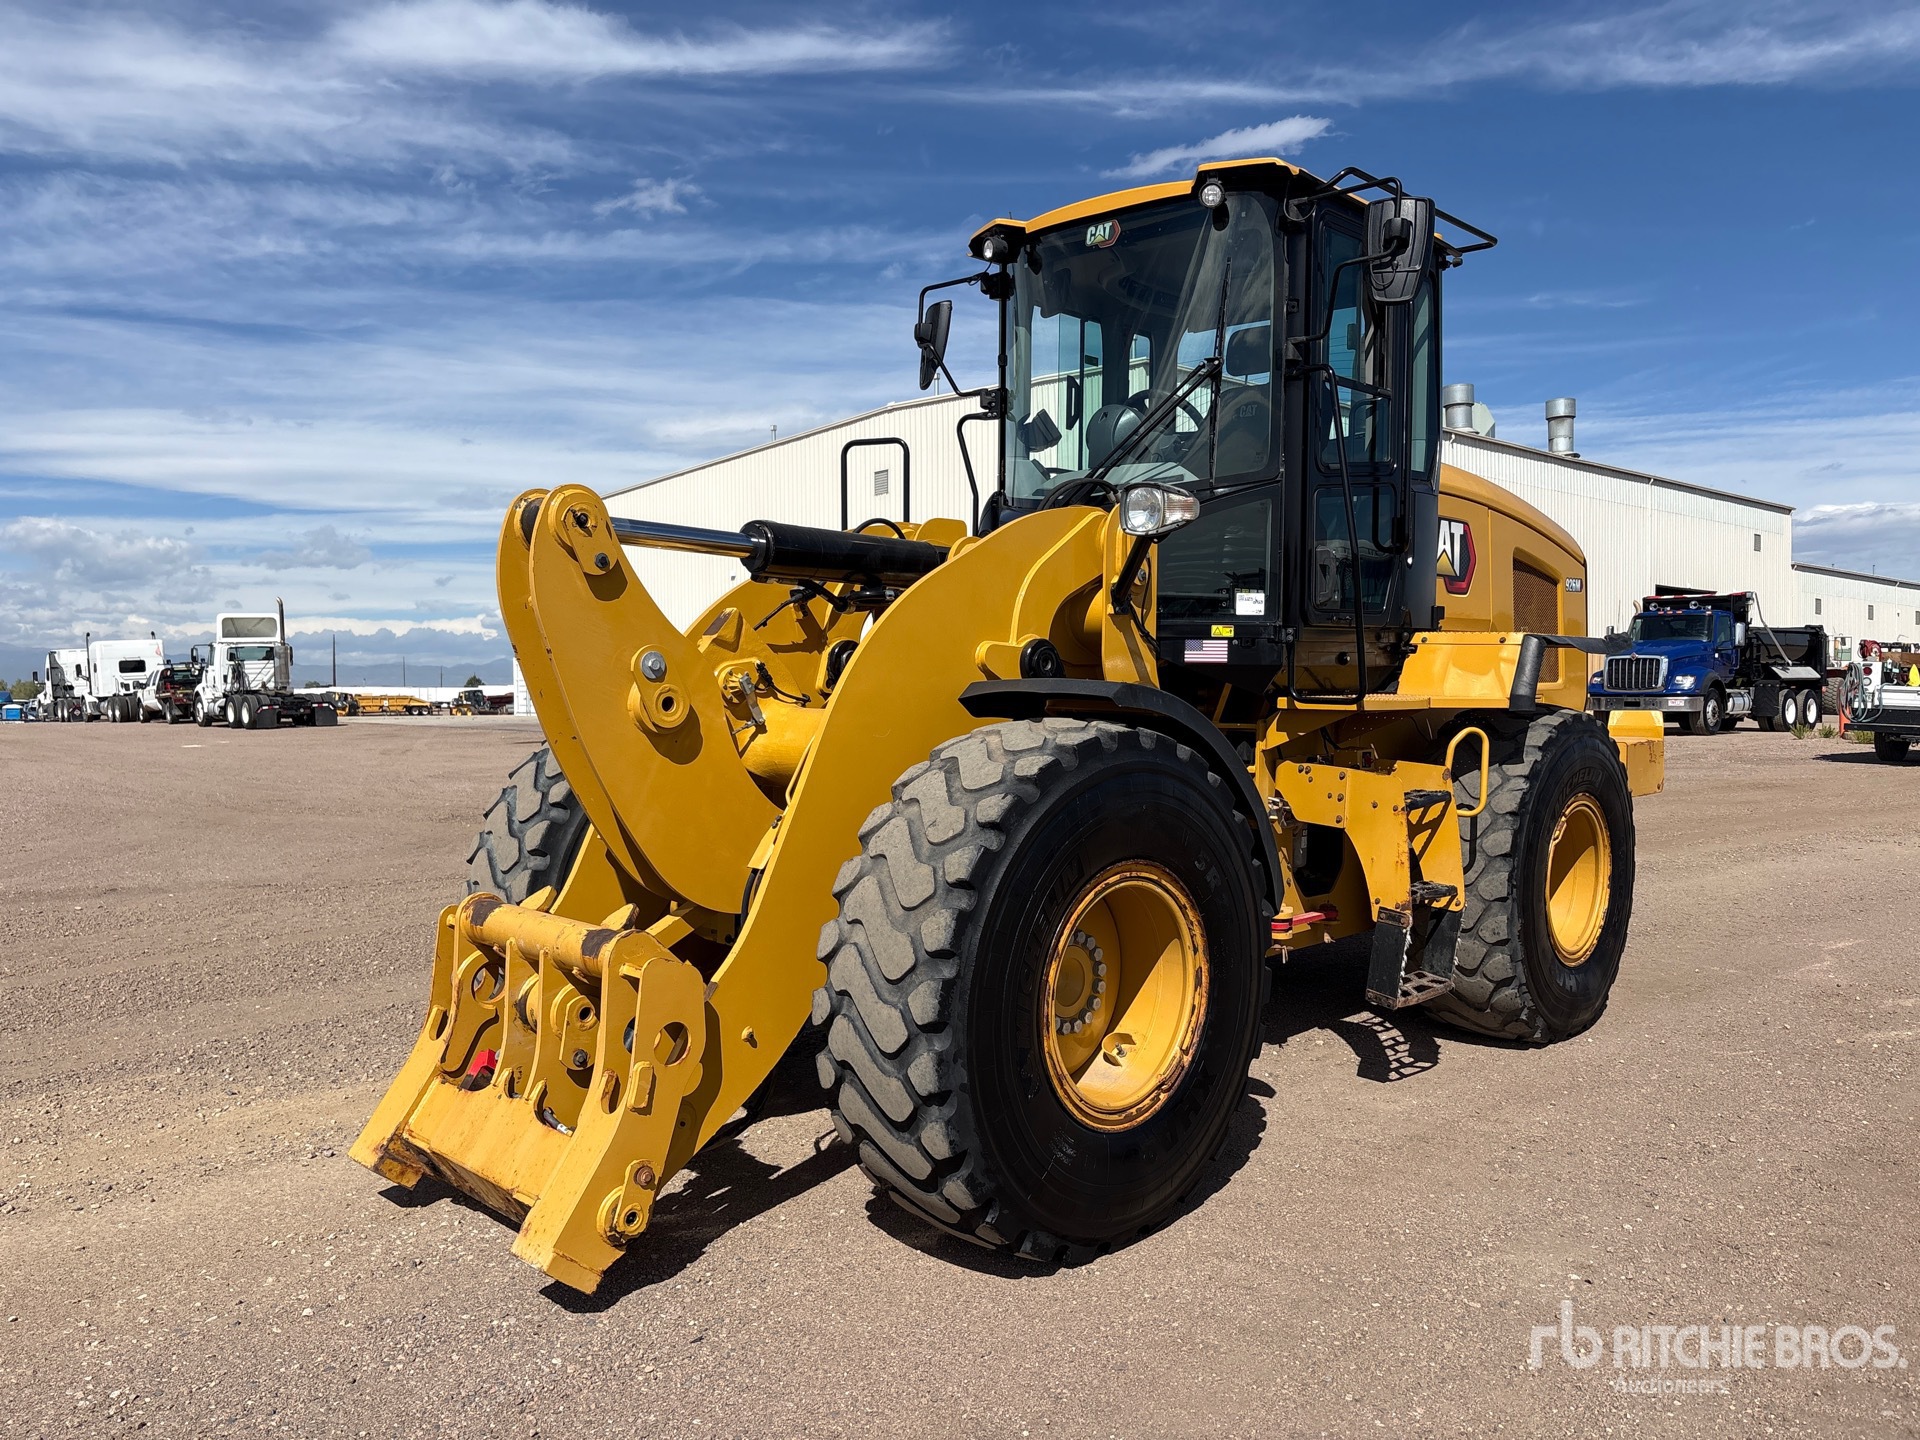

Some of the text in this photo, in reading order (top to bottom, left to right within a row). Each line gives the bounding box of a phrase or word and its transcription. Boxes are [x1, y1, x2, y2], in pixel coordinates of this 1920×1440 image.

[1086, 222, 1112, 245] CAT
[1240, 405, 1257, 417] CAT
[1437, 519, 1464, 577] AT
[1565, 578, 1581, 592] 926M
